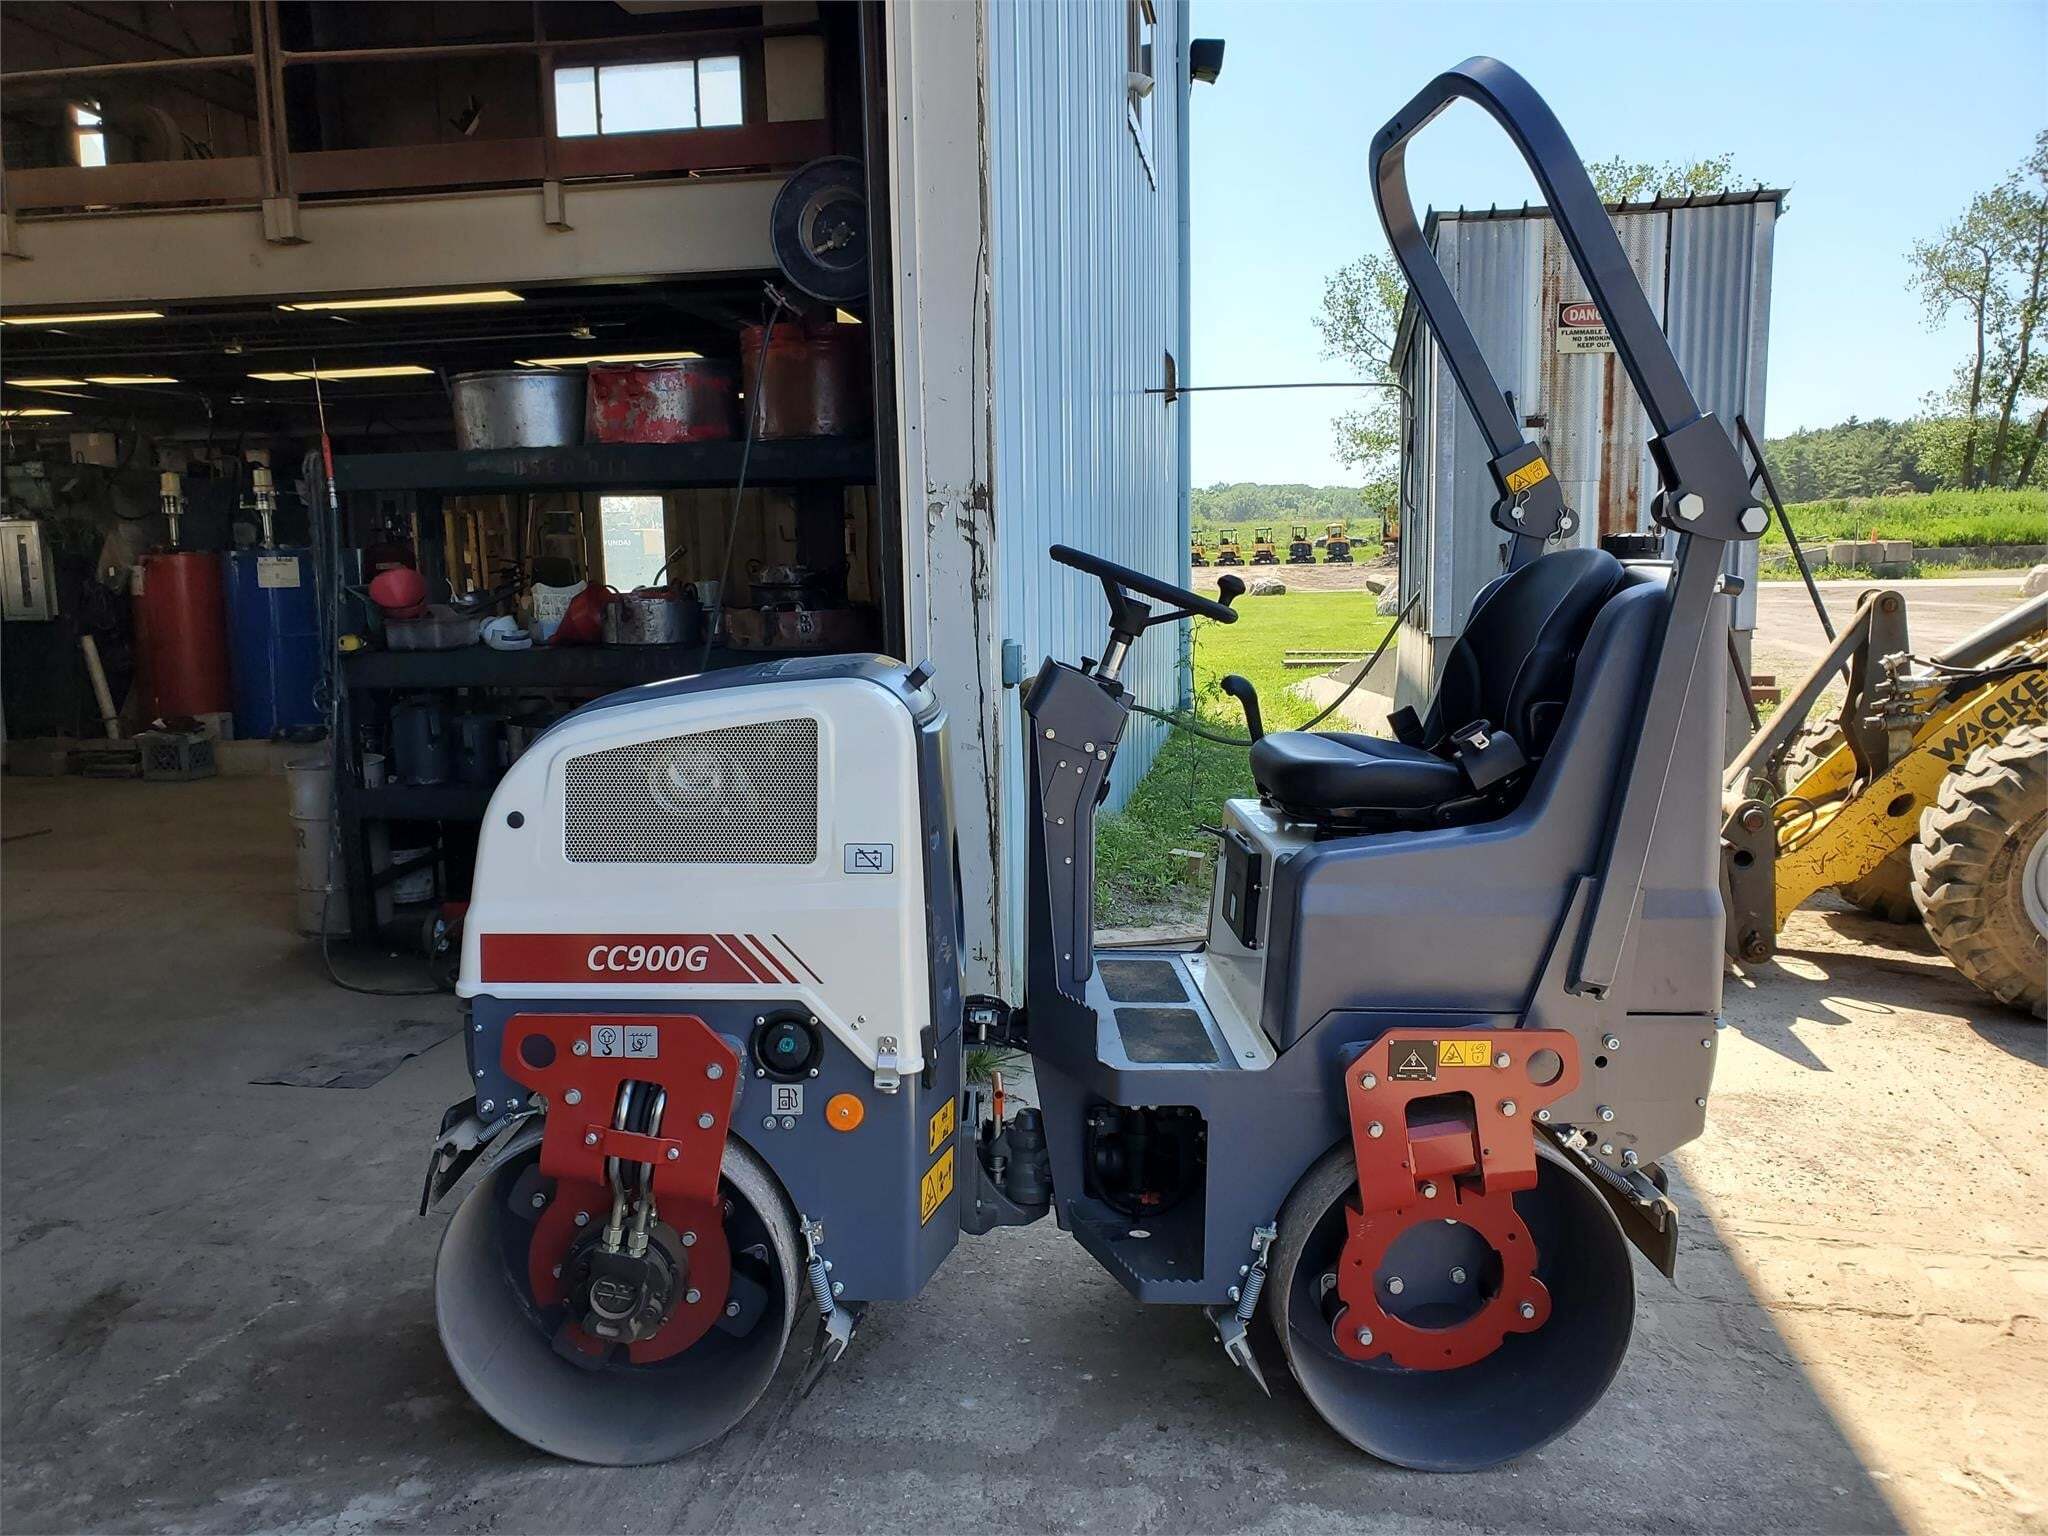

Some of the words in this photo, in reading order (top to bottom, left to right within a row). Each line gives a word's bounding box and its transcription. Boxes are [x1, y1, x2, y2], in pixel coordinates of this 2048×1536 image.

[1569, 308, 1602, 321] DANG
[1561, 328, 1603, 336] FLAMMABLE
[1927, 674, 2048, 762] WACKE
[586, 945, 710, 972] CC900G
